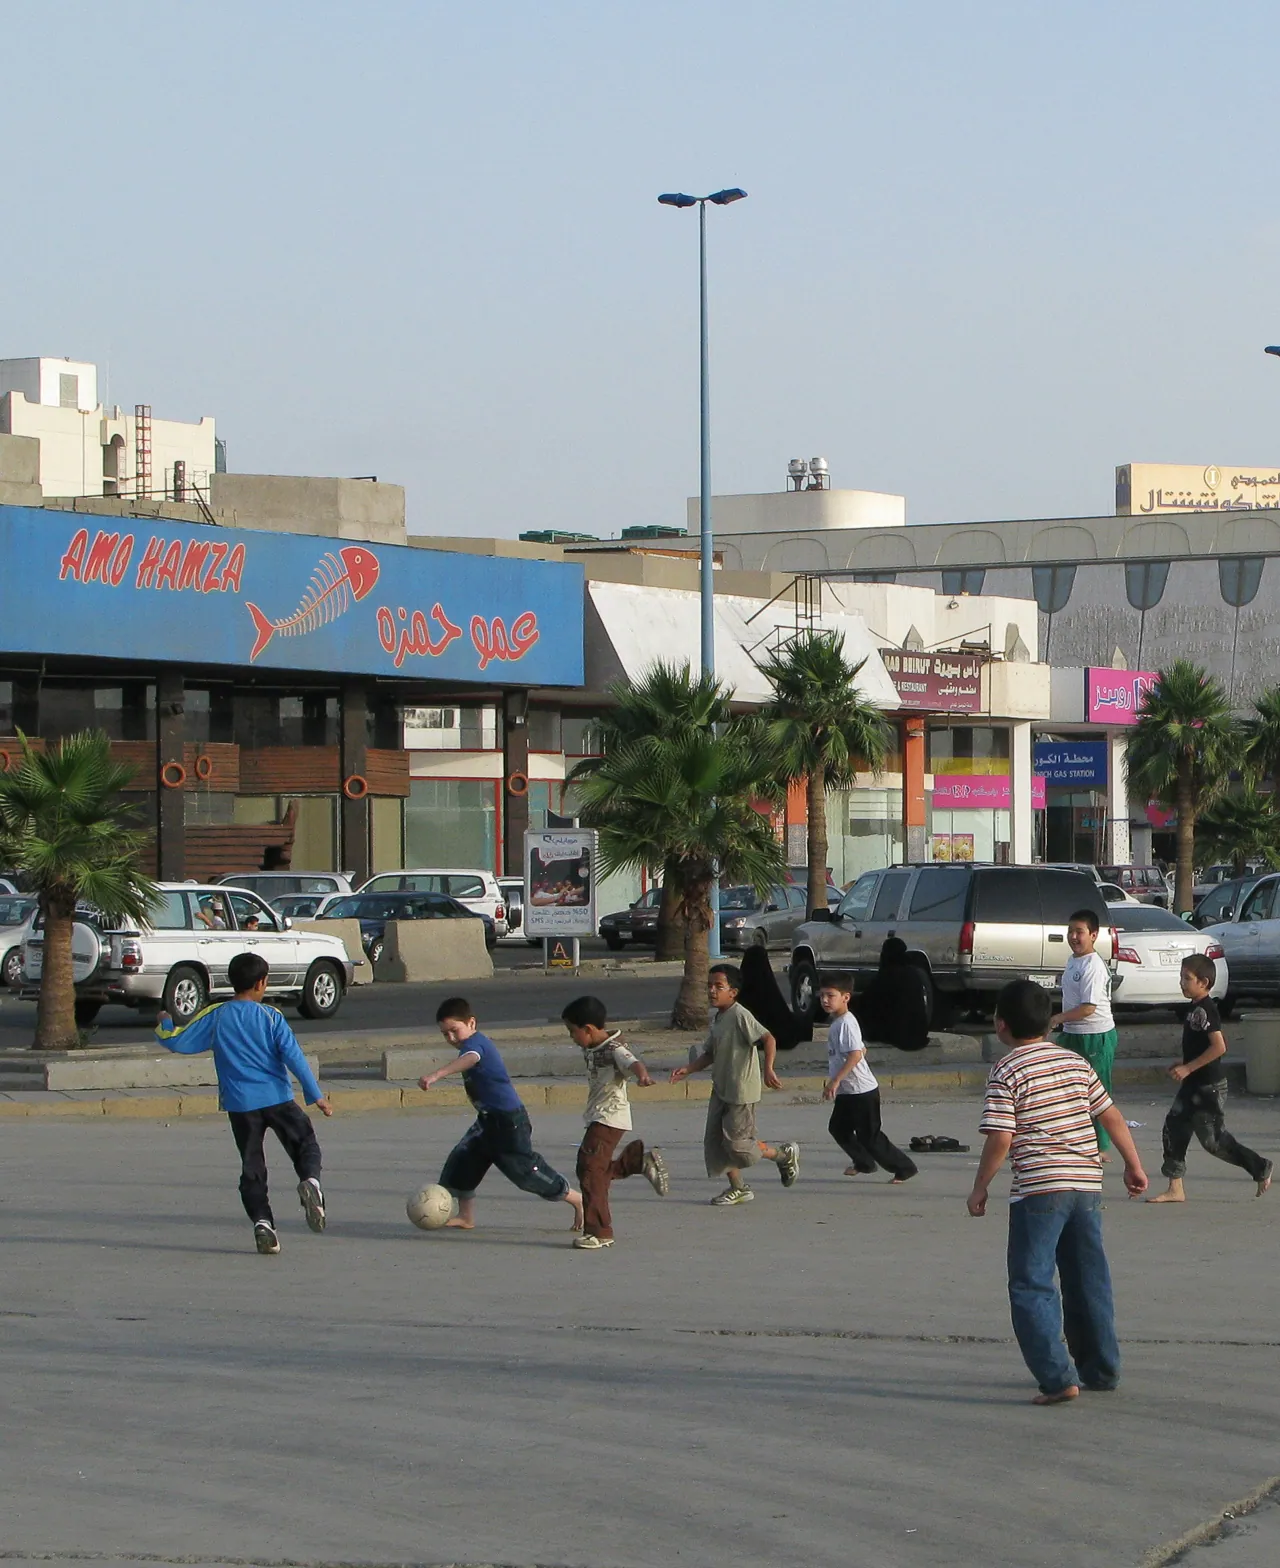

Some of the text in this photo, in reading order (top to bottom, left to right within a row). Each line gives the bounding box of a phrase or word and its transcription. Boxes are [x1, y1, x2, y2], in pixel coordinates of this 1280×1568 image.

[59, 528, 246, 594] AMO HAMZA
[470, 610, 540, 671] عمو
[902, 656, 931, 675] BEIRUT
[901, 681, 928, 693] RESTAURANT
[957, 684, 977, 697] مطعم
[1093, 685, 1132, 711] روبنز
[1063, 752, 1095, 764] محطة
[1053, 770, 1067, 778] GAS
[1069, 769, 1095, 778] STATION
